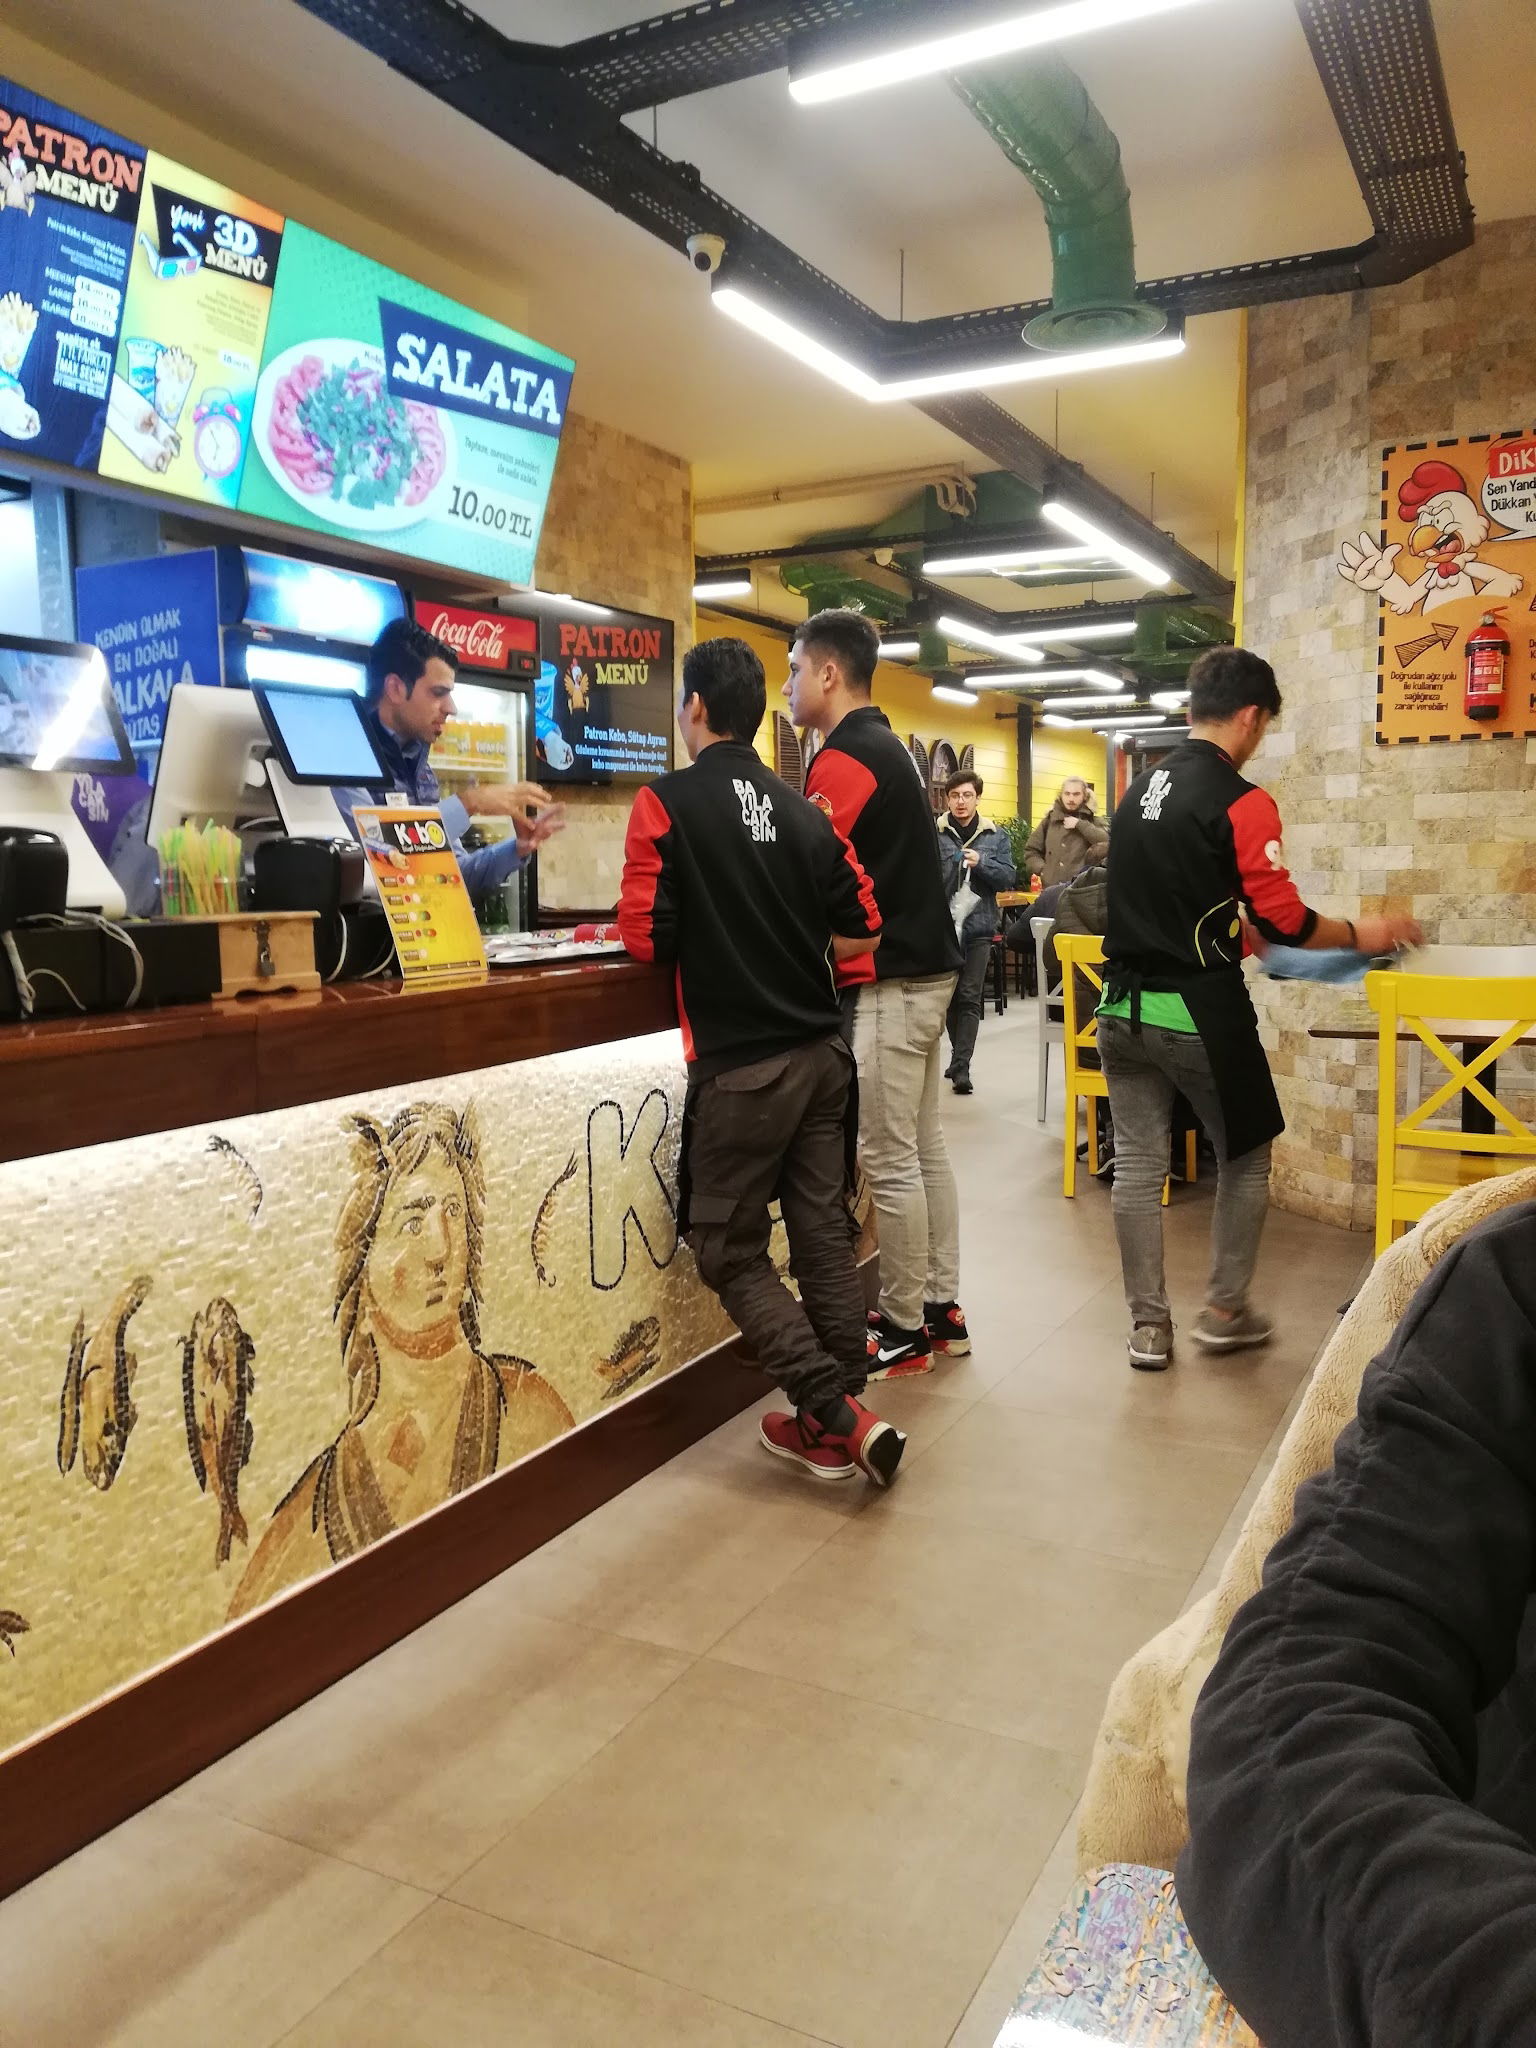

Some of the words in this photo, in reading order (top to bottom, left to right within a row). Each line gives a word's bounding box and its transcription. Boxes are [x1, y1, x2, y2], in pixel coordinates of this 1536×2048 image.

[36, 163, 119, 213] MENÜ
[213, 214, 259, 257] 3D
[204, 243, 268, 280] MENÜ
[392, 331, 561, 425] SALATA
[1487, 483, 1507, 496] Sen
[1491, 496, 1531, 511] Dükkan
[448, 485, 507, 530] 10.00
[509, 511, 533, 539] TL
[140, 608, 181, 637] OLMAK
[559, 623, 661, 659] PATRON
[114, 651, 131, 673] EN
[595, 658, 649, 685] MENÜ
[1391, 671, 1425, 682] Doğrudan
[1394, 703, 1415, 711] zarar
[583, 725, 608, 741] Patron
[647, 733, 667, 748] Ayran
[587, 1088, 678, 1291] K
